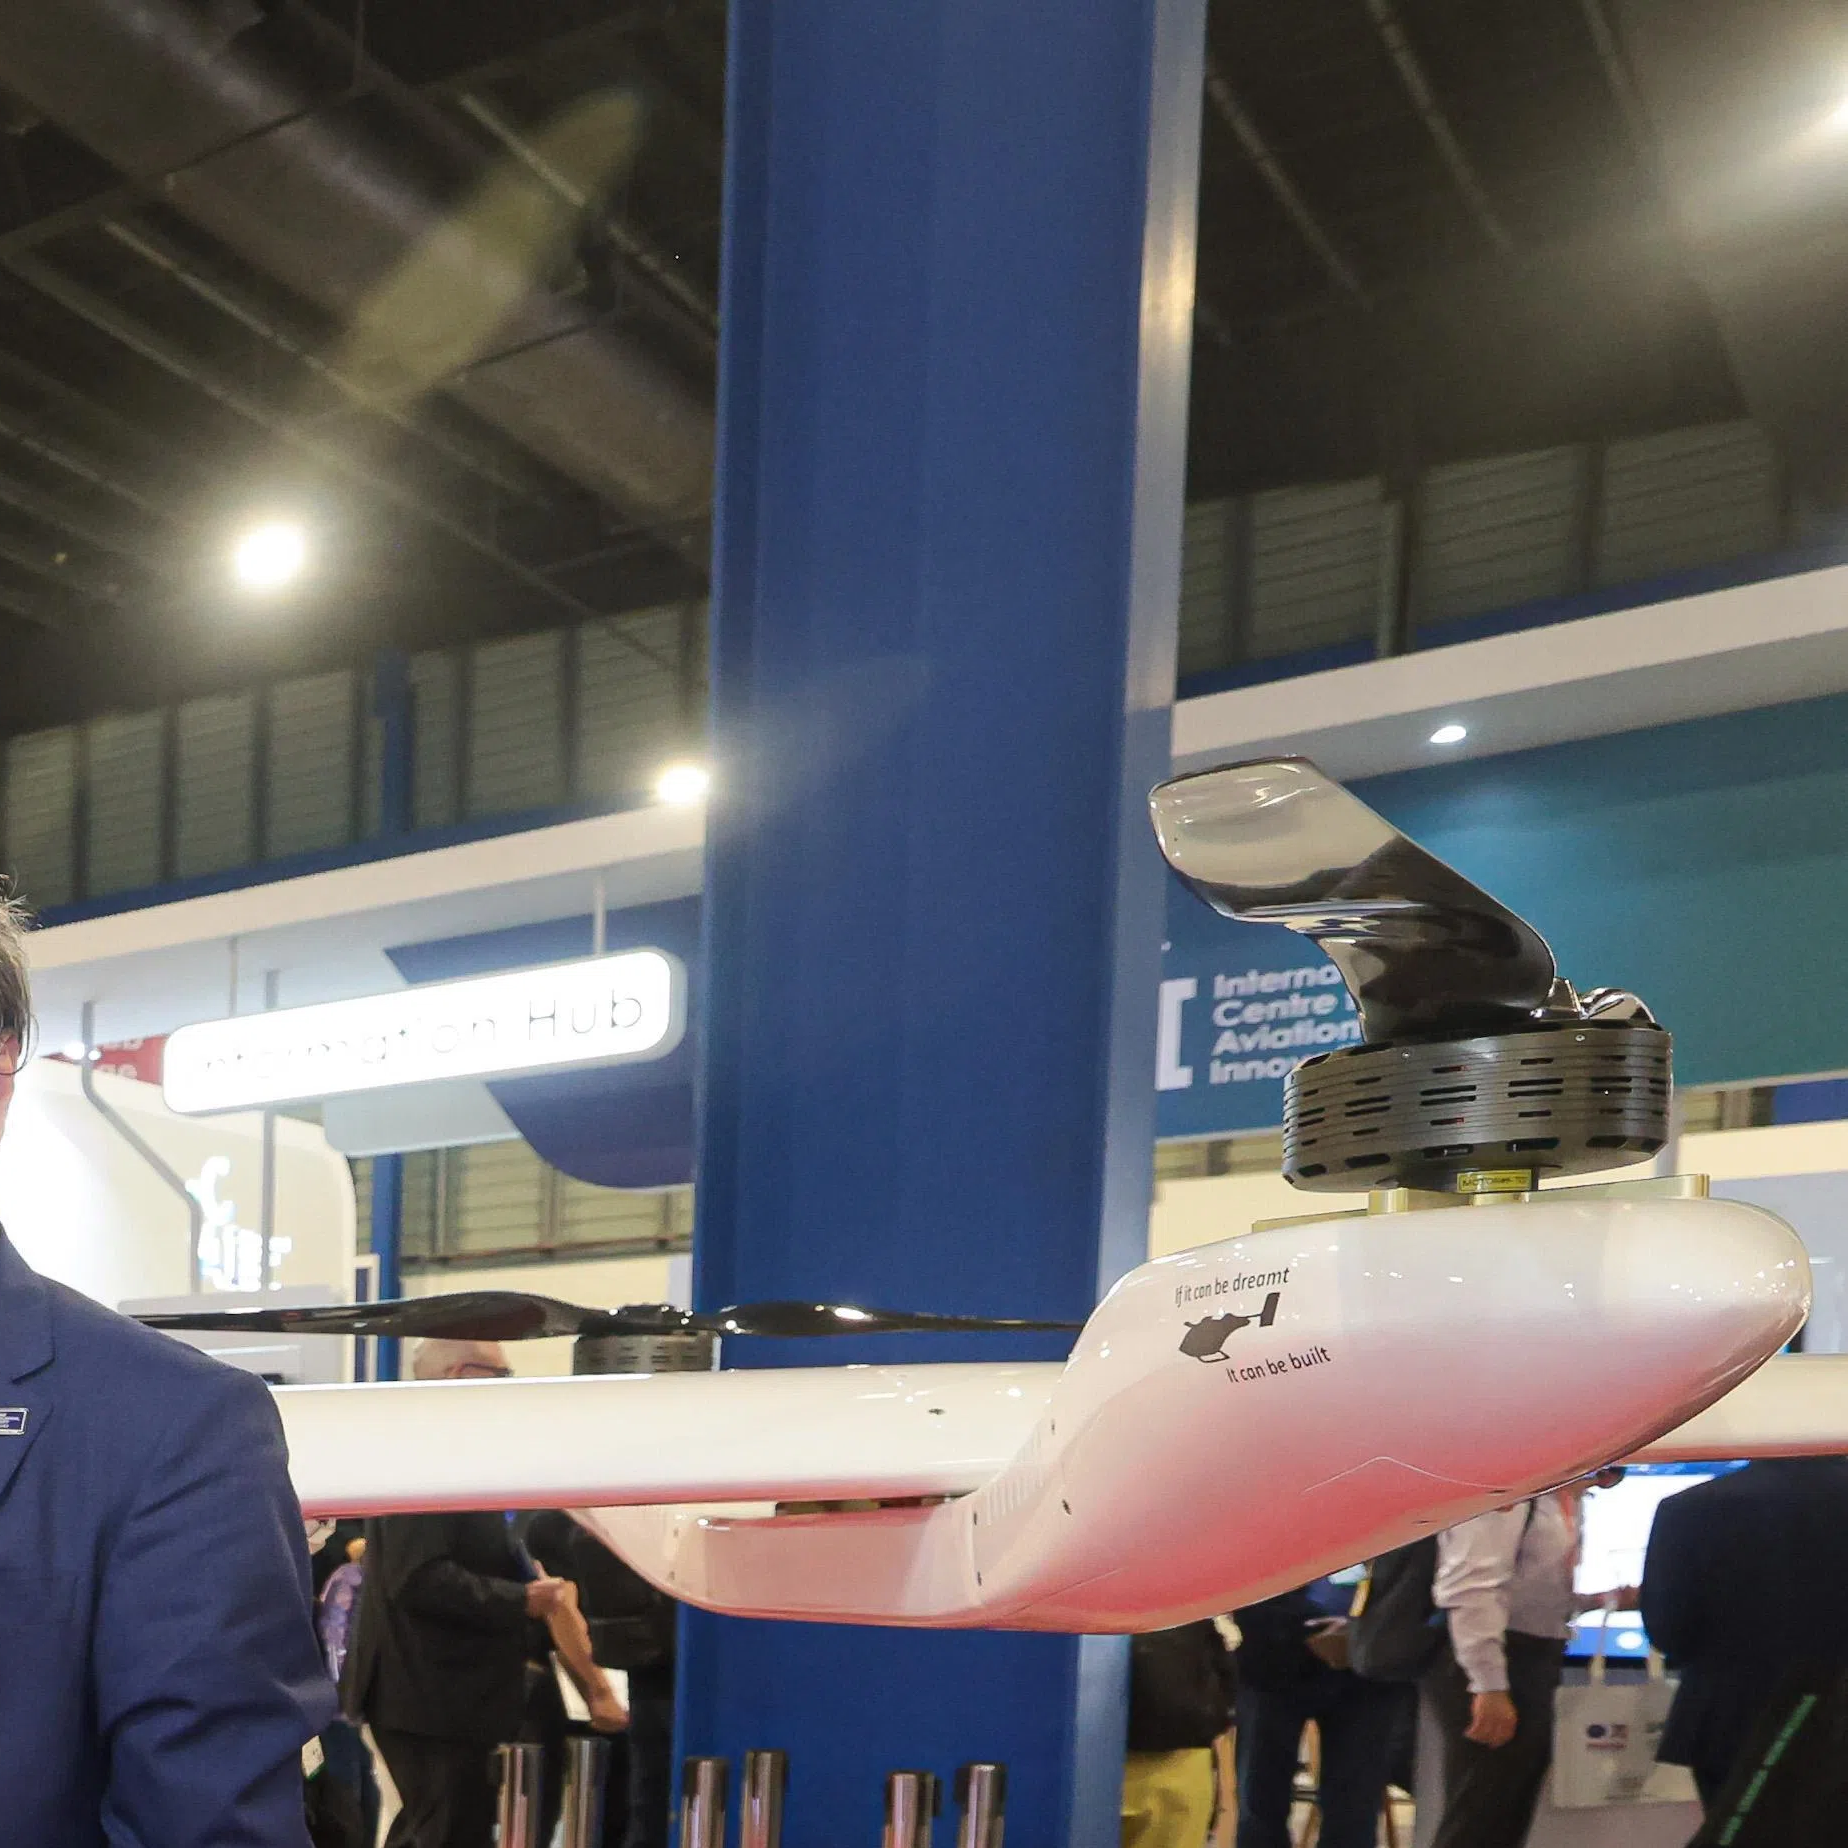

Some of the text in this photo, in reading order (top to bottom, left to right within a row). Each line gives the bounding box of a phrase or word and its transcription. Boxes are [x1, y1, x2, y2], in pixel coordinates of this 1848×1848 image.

[1213, 963, 1344, 1000] Interna
[1212, 993, 1338, 1027] Centre
[189, 988, 643, 1084] nformation Hub
[1211, 1018, 1363, 1056] Aviation
[1174, 1267, 1290, 1308] If it can be dreamt
[1226, 1346, 1332, 1383] It can be built
